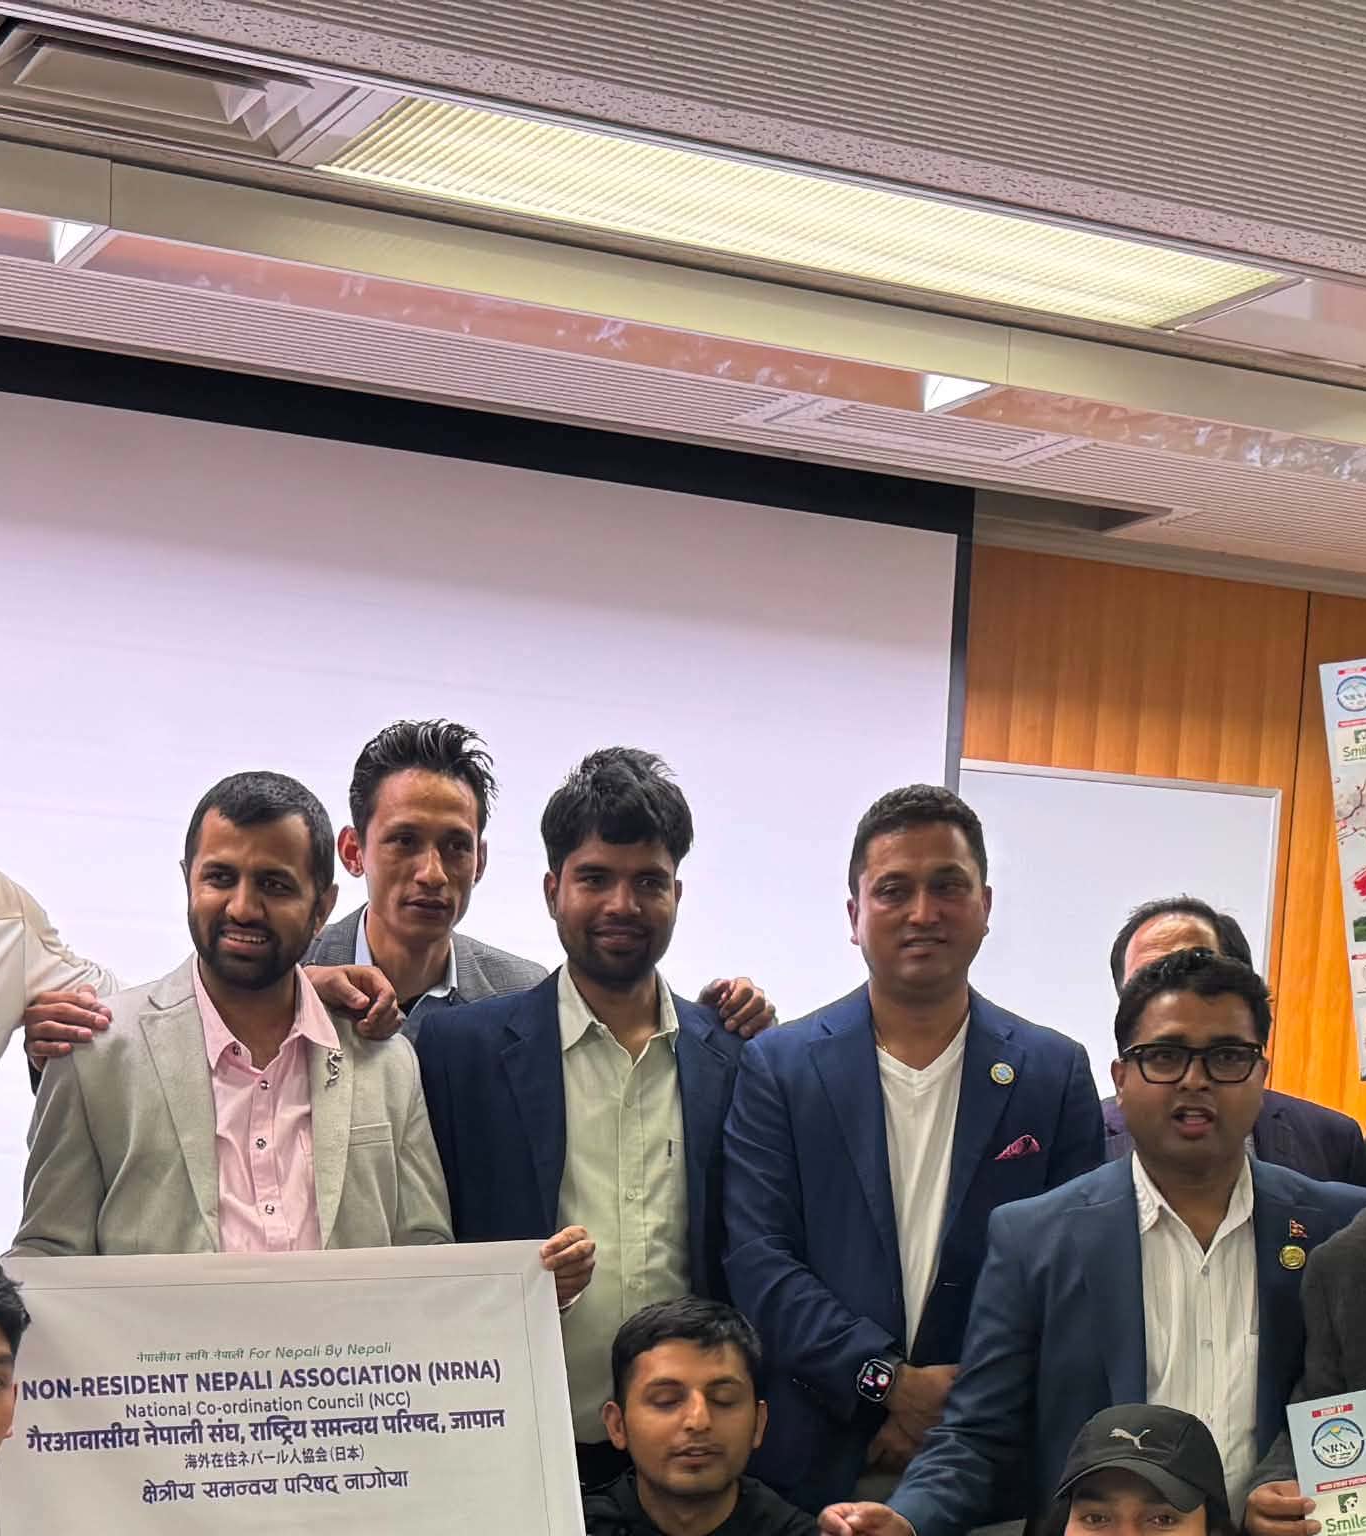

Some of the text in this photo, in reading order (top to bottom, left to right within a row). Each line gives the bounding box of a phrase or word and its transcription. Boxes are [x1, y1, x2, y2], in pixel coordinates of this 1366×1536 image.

[250, 1348, 270, 1360] For
[276, 1346, 320, 1360] Nepali
[326, 1345, 342, 1357] By
[348, 1342, 391, 1356] Nepali
[22, 1359, 501, 1400] NON-RESIDENT NEPALI ASSOCIATION (NRNA)
[126, 1391, 411, 1418] National Co-ordination Council (NCC)
[26, 1423, 140, 1452] गैरआवासीय
[144, 1418, 204, 1446] नेपाली
[449, 1409, 505, 1430] जापान
[1322, 1441, 1355, 1453] NRNA
[142, 1479, 195, 1503] क्षेत्रीय
[202, 1478, 278, 1498] समन्वय
[344, 1467, 409, 1490] नागोया
